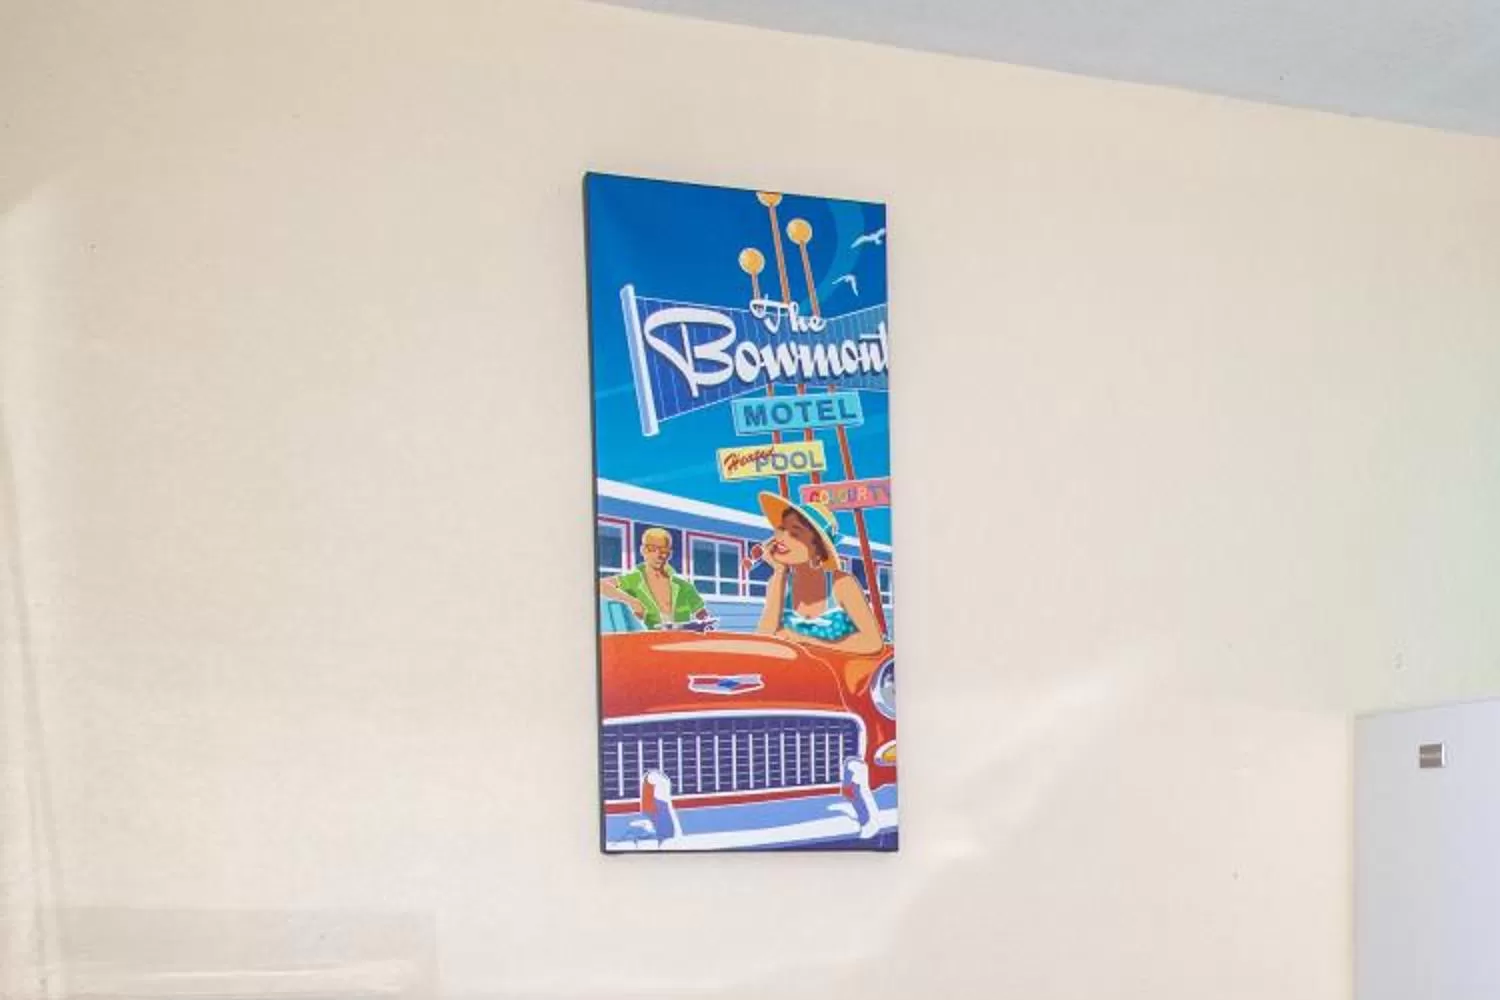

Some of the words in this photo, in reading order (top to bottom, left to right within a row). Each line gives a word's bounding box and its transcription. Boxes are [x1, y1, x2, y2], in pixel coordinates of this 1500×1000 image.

[750, 295, 827, 333] The
[643, 306, 889, 398] Bowmont
[743, 398, 857, 427] MOTEL
[755, 450, 824, 473] POOL
